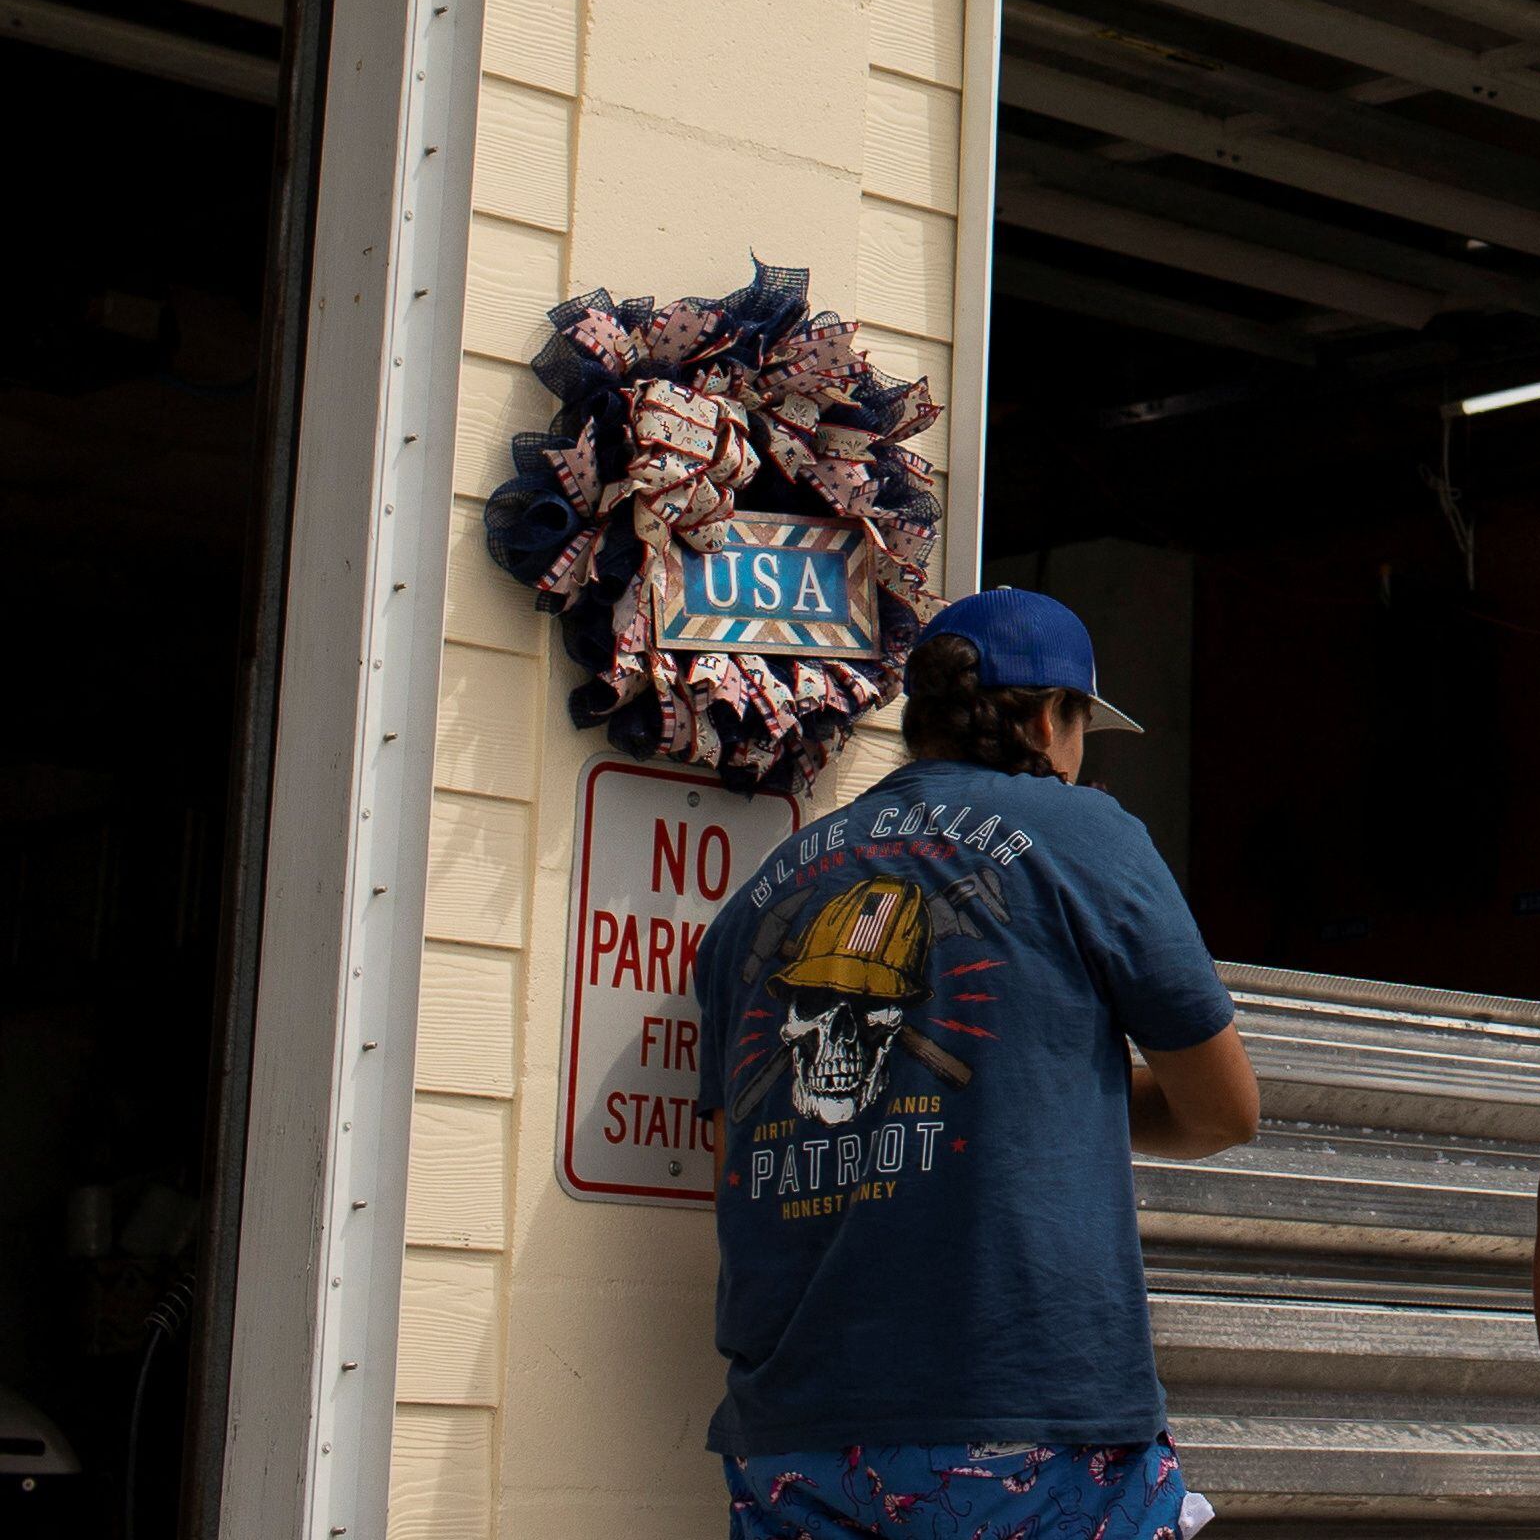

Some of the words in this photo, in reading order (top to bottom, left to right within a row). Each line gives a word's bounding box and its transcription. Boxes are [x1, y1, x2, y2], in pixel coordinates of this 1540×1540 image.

[701, 551, 832, 613] USA
[651, 818, 731, 901] NO
[751, 818, 848, 907] BLUE
[870, 802, 1032, 865] COLLAR
[589, 910, 706, 996] PARK
[641, 1016, 699, 1072] FIR
[753, 1118, 798, 1142] DIRTY
[886, 1096, 941, 1117] ANDS
[782, 1195, 844, 1220] HONEST
